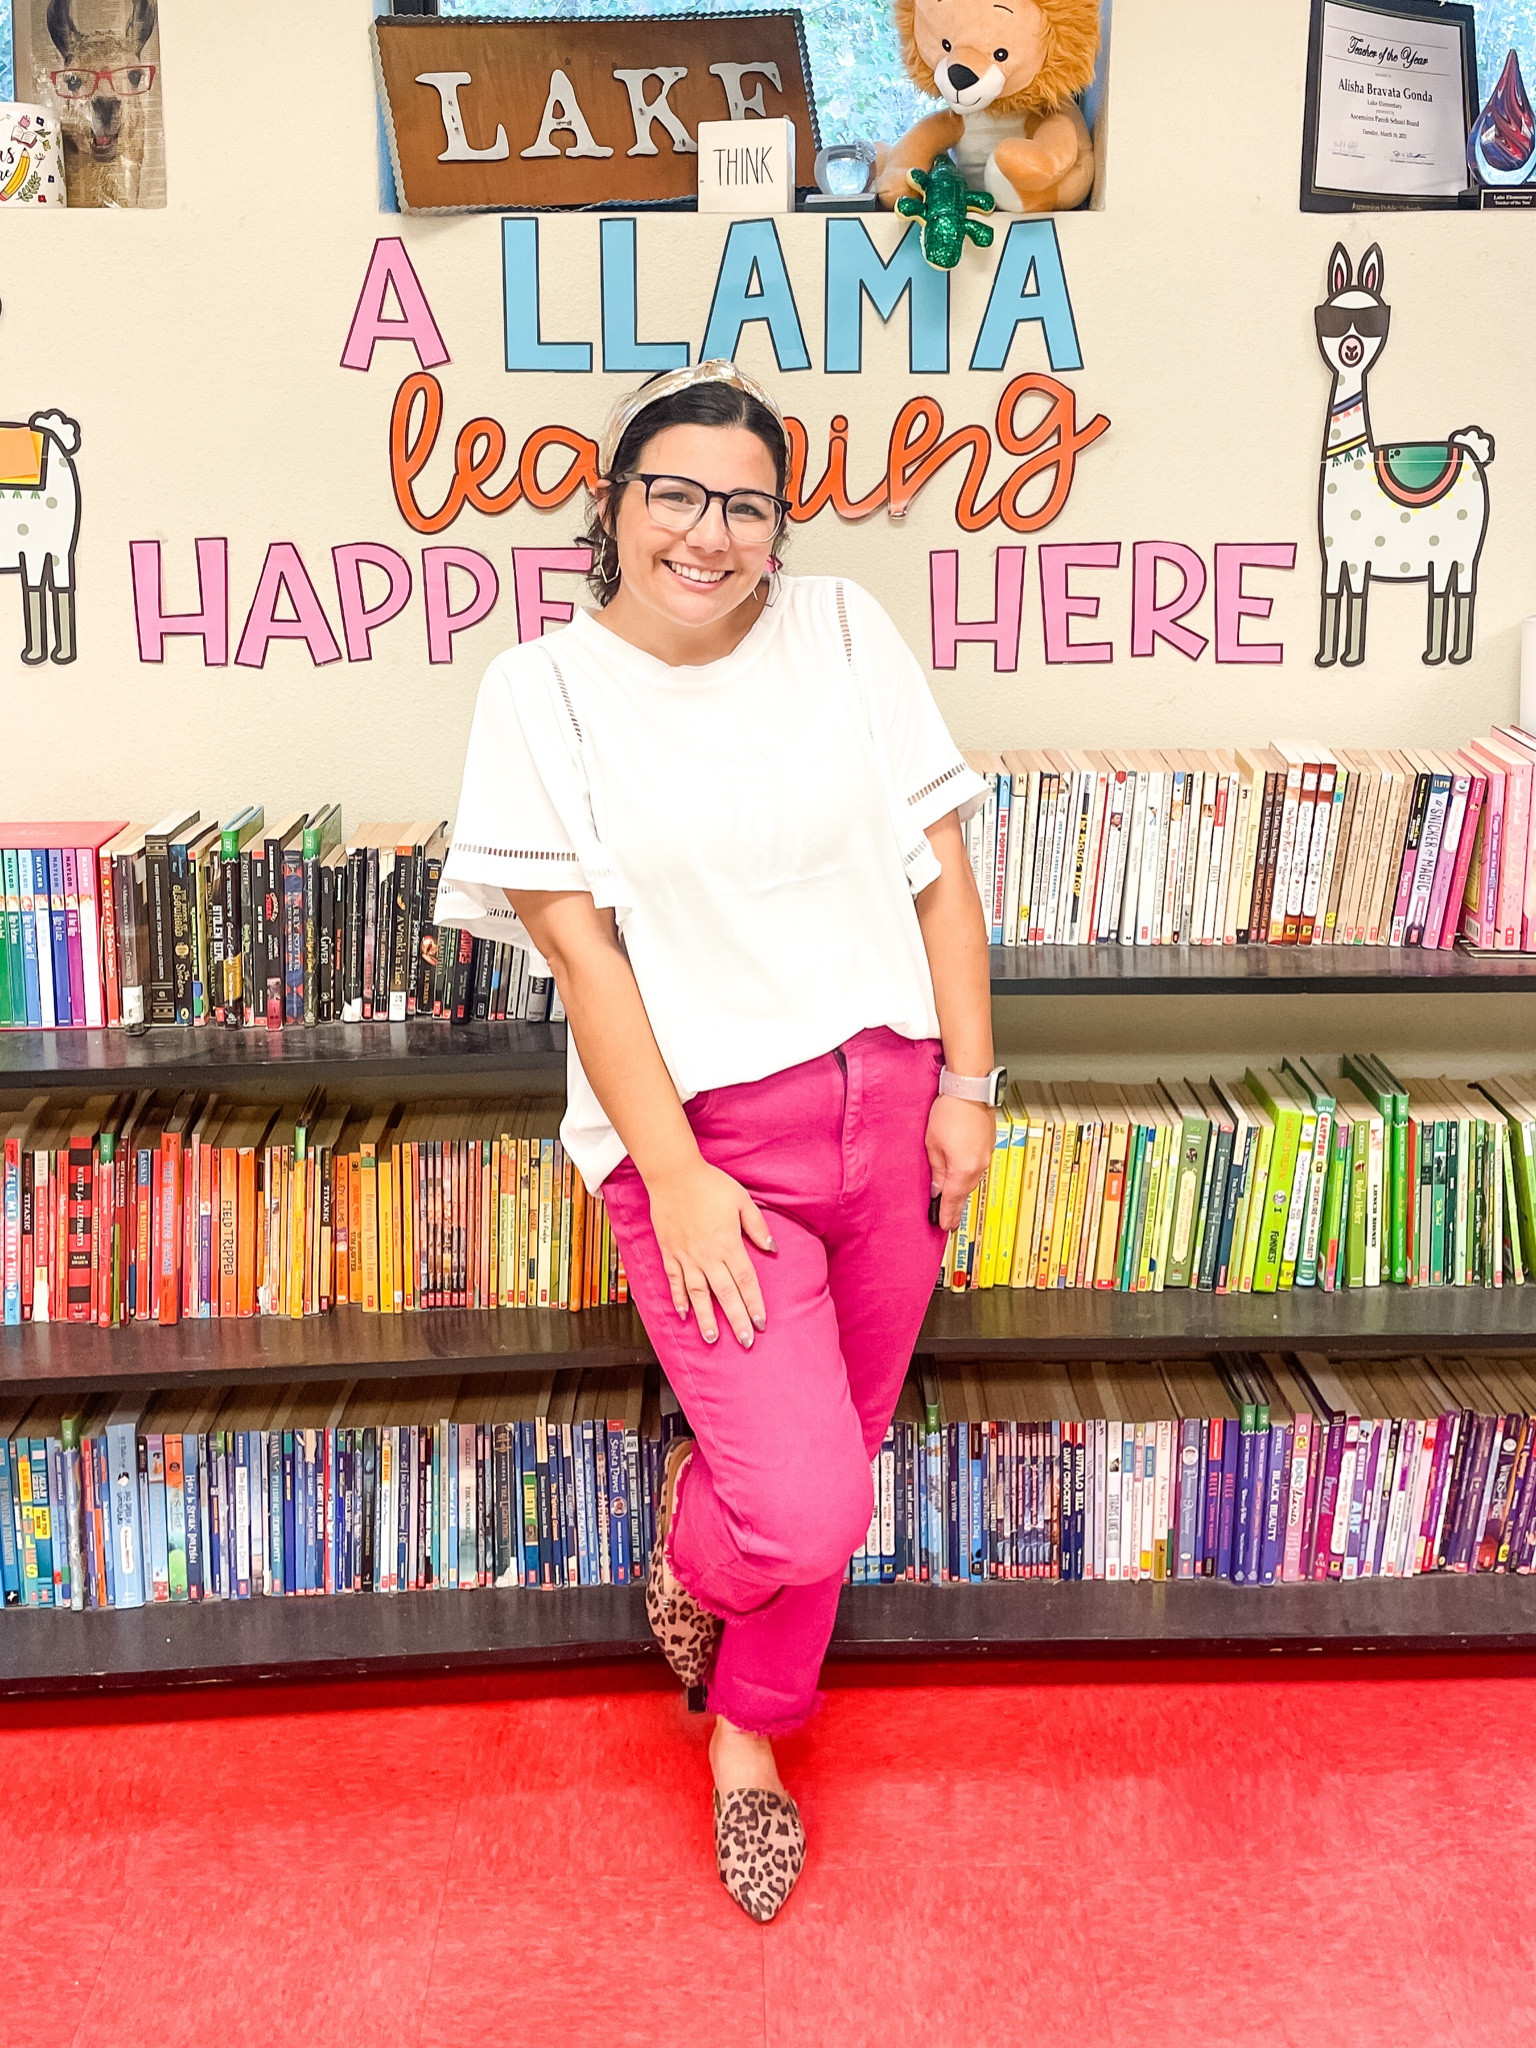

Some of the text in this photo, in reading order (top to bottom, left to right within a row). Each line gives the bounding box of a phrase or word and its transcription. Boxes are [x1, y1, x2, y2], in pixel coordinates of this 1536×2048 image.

[1347, 35, 1428, 69] Teacher of the Year
[1338, 78, 1433, 102] Alisha Bravata Gonda
[1378, 100, 1402, 110] Elementary
[1350, 113, 1374, 122] Ascension
[1375, 116, 1389, 124] Parish
[1389, 118, 1405, 126] School
[1380, 130, 1392, 138] March
[713, 145, 774, 187] THINK
[340, 217, 1084, 374] A LLAMA
[130, 537, 1298, 672] HAPPE HERE
[1249, 824, 1257, 845] Because
[1282, 816, 1294, 853] Wimpy Kid
[1416, 808, 1443, 892] SNICKER MAGIC
[35, 856, 44, 888] NAYLOR
[65, 856, 73, 888] NAYLOR
[82, 856, 90, 888] NAYLOR
[367, 860, 375, 884] pictures
[985, 820, 994, 888] TOUCHING SPIRIT
[995, 814, 1008, 920] MR. POPPER'S PENGUINS
[1042, 848, 1050, 882] CHOCOLATE
[1072, 814, 1089, 897] The Magic Trap
[367, 884, 375, 892] of
[173, 885, 183, 937] ELSEWHERE
[213, 905, 223, 939] STOLEN
[292, 892, 301, 971] HARRY POTTER
[320, 935, 331, 964] GIVER
[394, 915, 404, 985] A Wrinkle in Time
[175, 963, 186, 999] Shadows
[1064, 1130, 1075, 1153] Roald
[1358, 1124, 1366, 1154] CREECH
[140, 1152, 149, 1183] RASKIN
[23, 1192, 32, 1233] TITANIC
[75, 1166, 85, 1247] WATER for ELEPHANTS
[162, 1160, 174, 1275] THE TRADING GAME
[322, 1184, 330, 1224] TITANIC
[337, 1175, 346, 1224] JUDY BLUME
[1353, 1179, 1364, 1225] Ruby Holler
[6, 1168, 18, 1300] TELL ME EVERYTHING
[139, 1214, 148, 1245] WESTING
[222, 1199, 234, 1276] FIELD TRIPPED
[364, 1193, 376, 1260] Becoming Naomi
[540, 1225, 549, 1244] Fudge
[1306, 1185, 1322, 1258] CREATURE CLOSET
[1371, 1216, 1379, 1249] MONEY
[957, 1234, 968, 1268] for Kids
[1268, 1230, 1280, 1264] FUNNIEST
[21, 1467, 31, 1496] LORD
[610, 1439, 621, 1493] Santa Paws
[1063, 1447, 1072, 1517] DAVY CROCKETT
[1075, 1448, 1084, 1511] BUFFALO BILL
[1293, 1459, 1304, 1489] DORK
[1356, 1446, 1366, 1481] QUINN
[525, 1484, 536, 1519] LIBERTY
[959, 1425, 968, 1556] BUNTING SUMMER RILEY
[1208, 1471, 1218, 1498] HOLES
[1224, 1473, 1234, 1500] HOLES
[1319, 1476, 1336, 1516] Braced
[185, 1474, 198, 1564] How SPEAK DOLPHIN
[464, 1500, 472, 1540] WANDERER
[971, 1476, 981, 1540] How Steal Dog
[1108, 1494, 1120, 1531] STRAYS LIKE
[1266, 1469, 1281, 1542] BLACK BEAUTY
[1349, 1500, 1362, 1535] ARF
[1491, 1498, 1506, 1520] FIRE
[22, 1505, 38, 1578] RULES
[238, 1484, 246, 1573] Hero Two Doors Down
